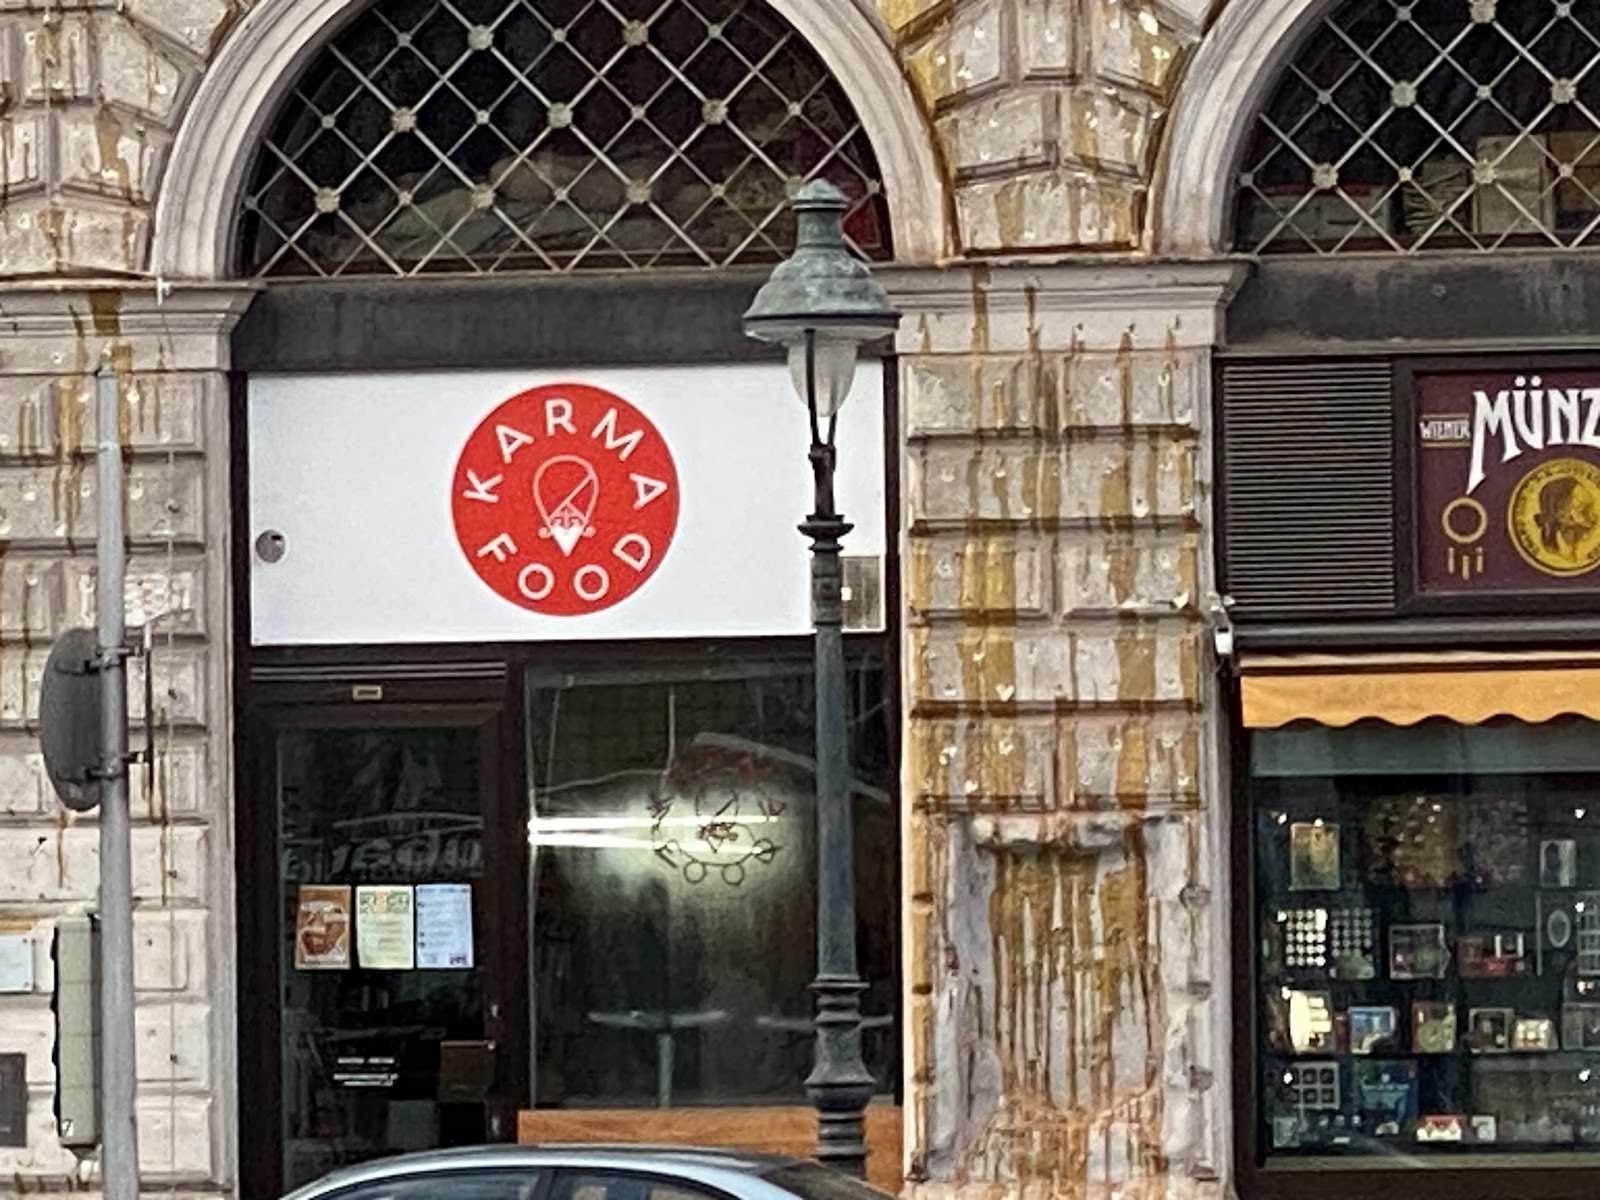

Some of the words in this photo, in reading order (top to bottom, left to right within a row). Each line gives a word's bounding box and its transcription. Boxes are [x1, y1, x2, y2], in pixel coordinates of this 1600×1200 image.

[463, 398, 668, 510] KARMA
[1419, 419, 1471, 440] WIENER
[1466, 375, 1600, 495] MÜNZ
[477, 533, 652, 601] FOOD
